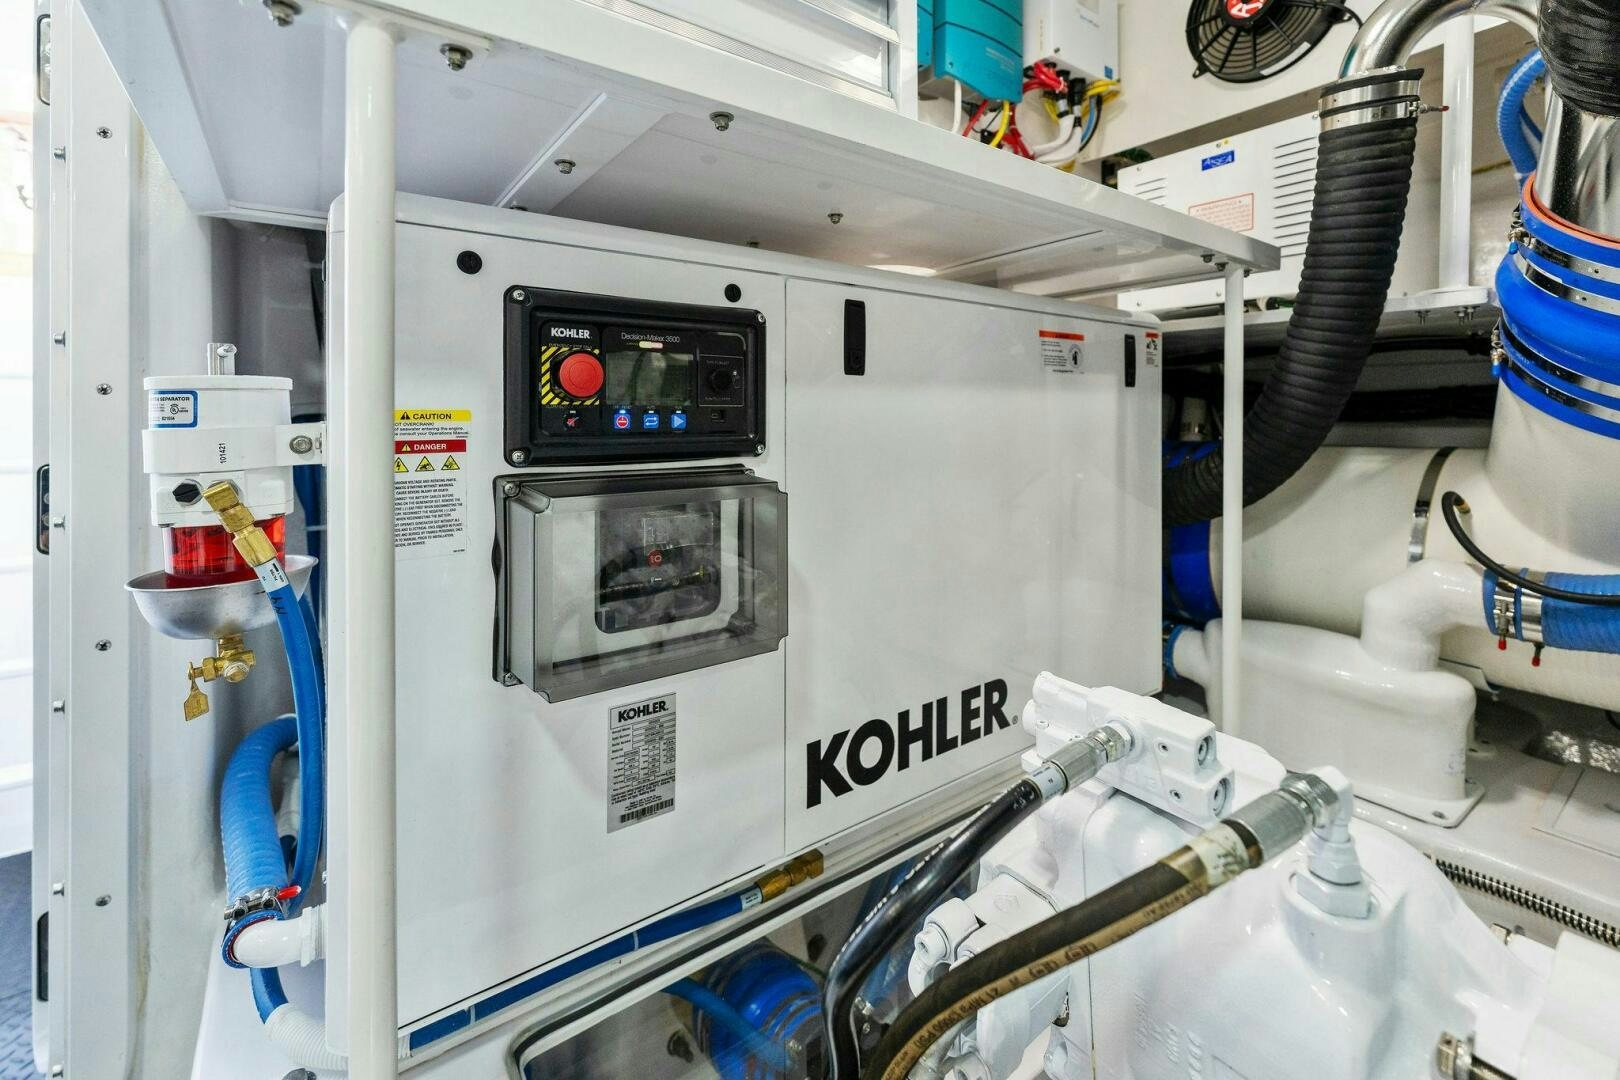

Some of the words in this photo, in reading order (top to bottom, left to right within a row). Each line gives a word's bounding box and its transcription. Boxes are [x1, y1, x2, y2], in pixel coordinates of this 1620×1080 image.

[551, 327, 590, 339] KOHLER
[218, 443, 227, 464] 101421
[618, 700, 667, 723] KOHLER
[804, 678, 1011, 810] KOHLER
